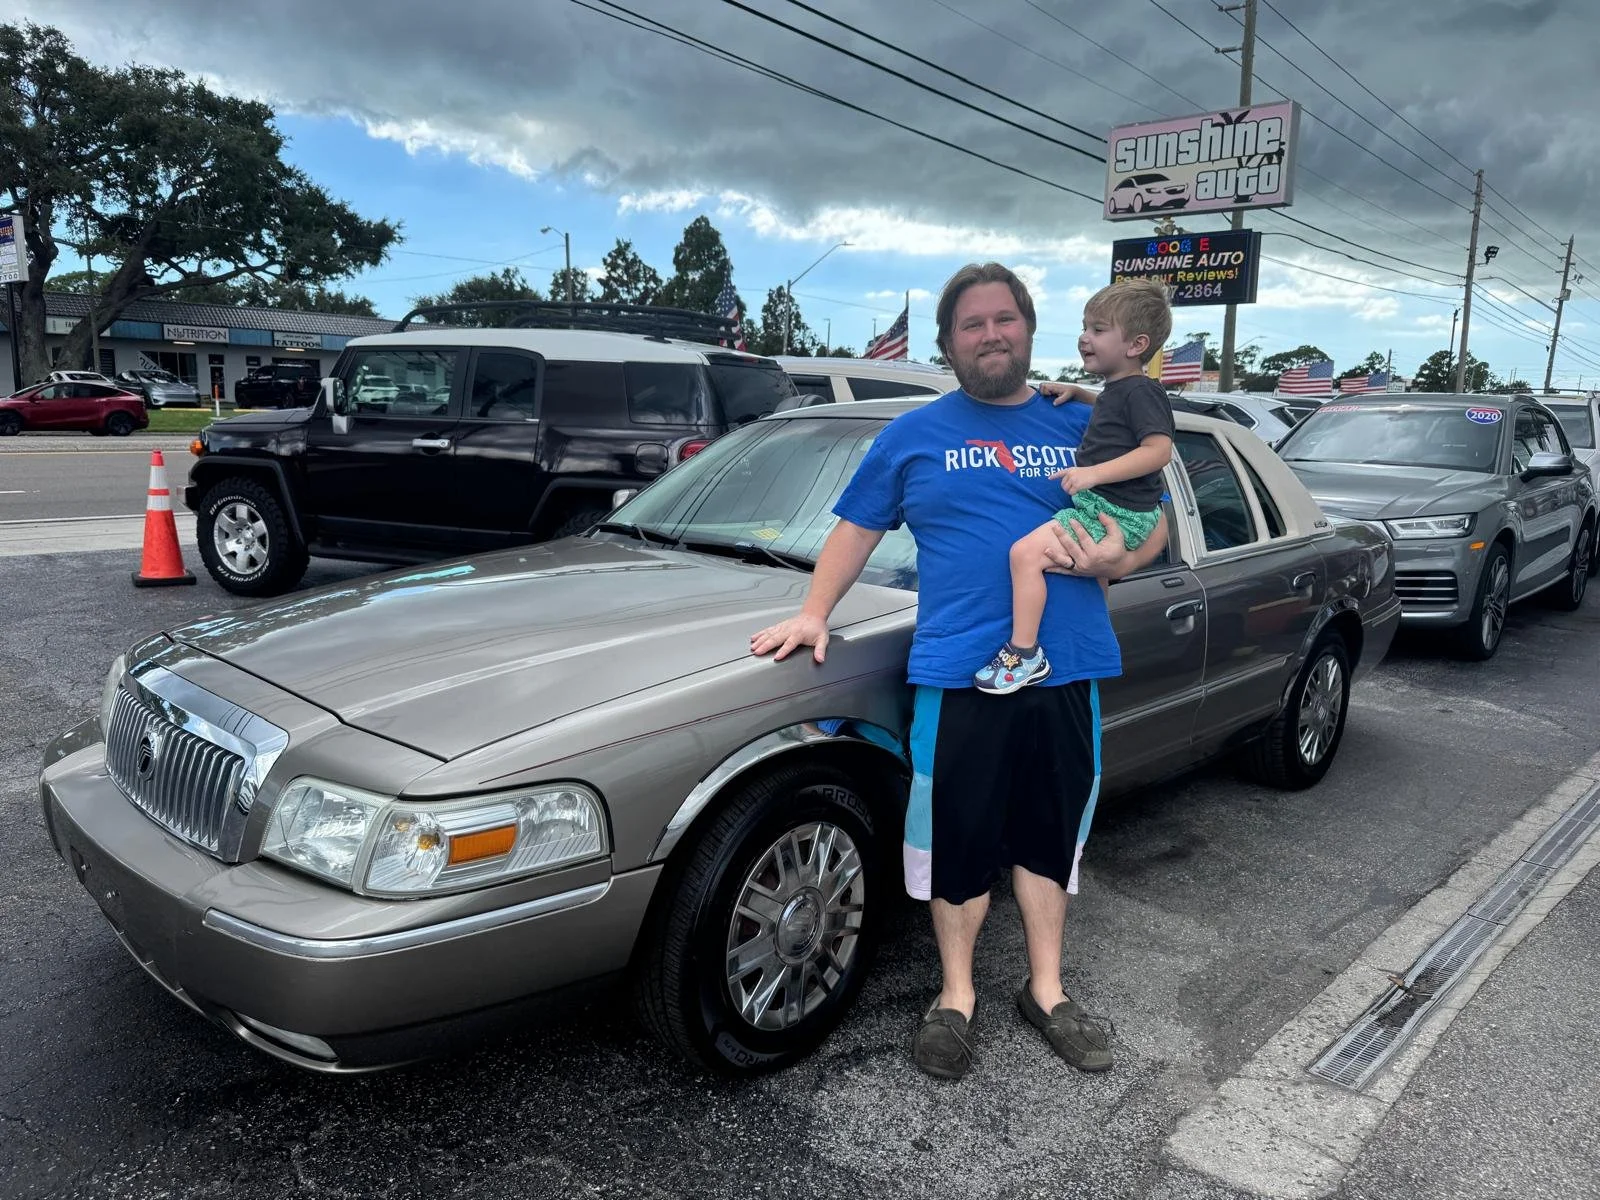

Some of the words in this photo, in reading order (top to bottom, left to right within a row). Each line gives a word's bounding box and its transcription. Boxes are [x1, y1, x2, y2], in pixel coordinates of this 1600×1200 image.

[1115, 117, 1283, 173] sunshine
[1195, 164, 1281, 200] auto
[1146, 237, 1210, 255] GOOGE
[1113, 254, 1194, 273] SUNSHINE
[1196, 250, 1244, 267] AUTO
[1177, 268, 1239, 282] Reviews!
[167, 327, 227, 340] NUTRITION
[275, 339, 321, 348] TATTOOS
[1471, 411, 1498, 421] 2020
[945, 446, 1001, 472] RICK
[1011, 445, 1078, 468] SCOTT
[1020, 467, 1041, 478] FOR
